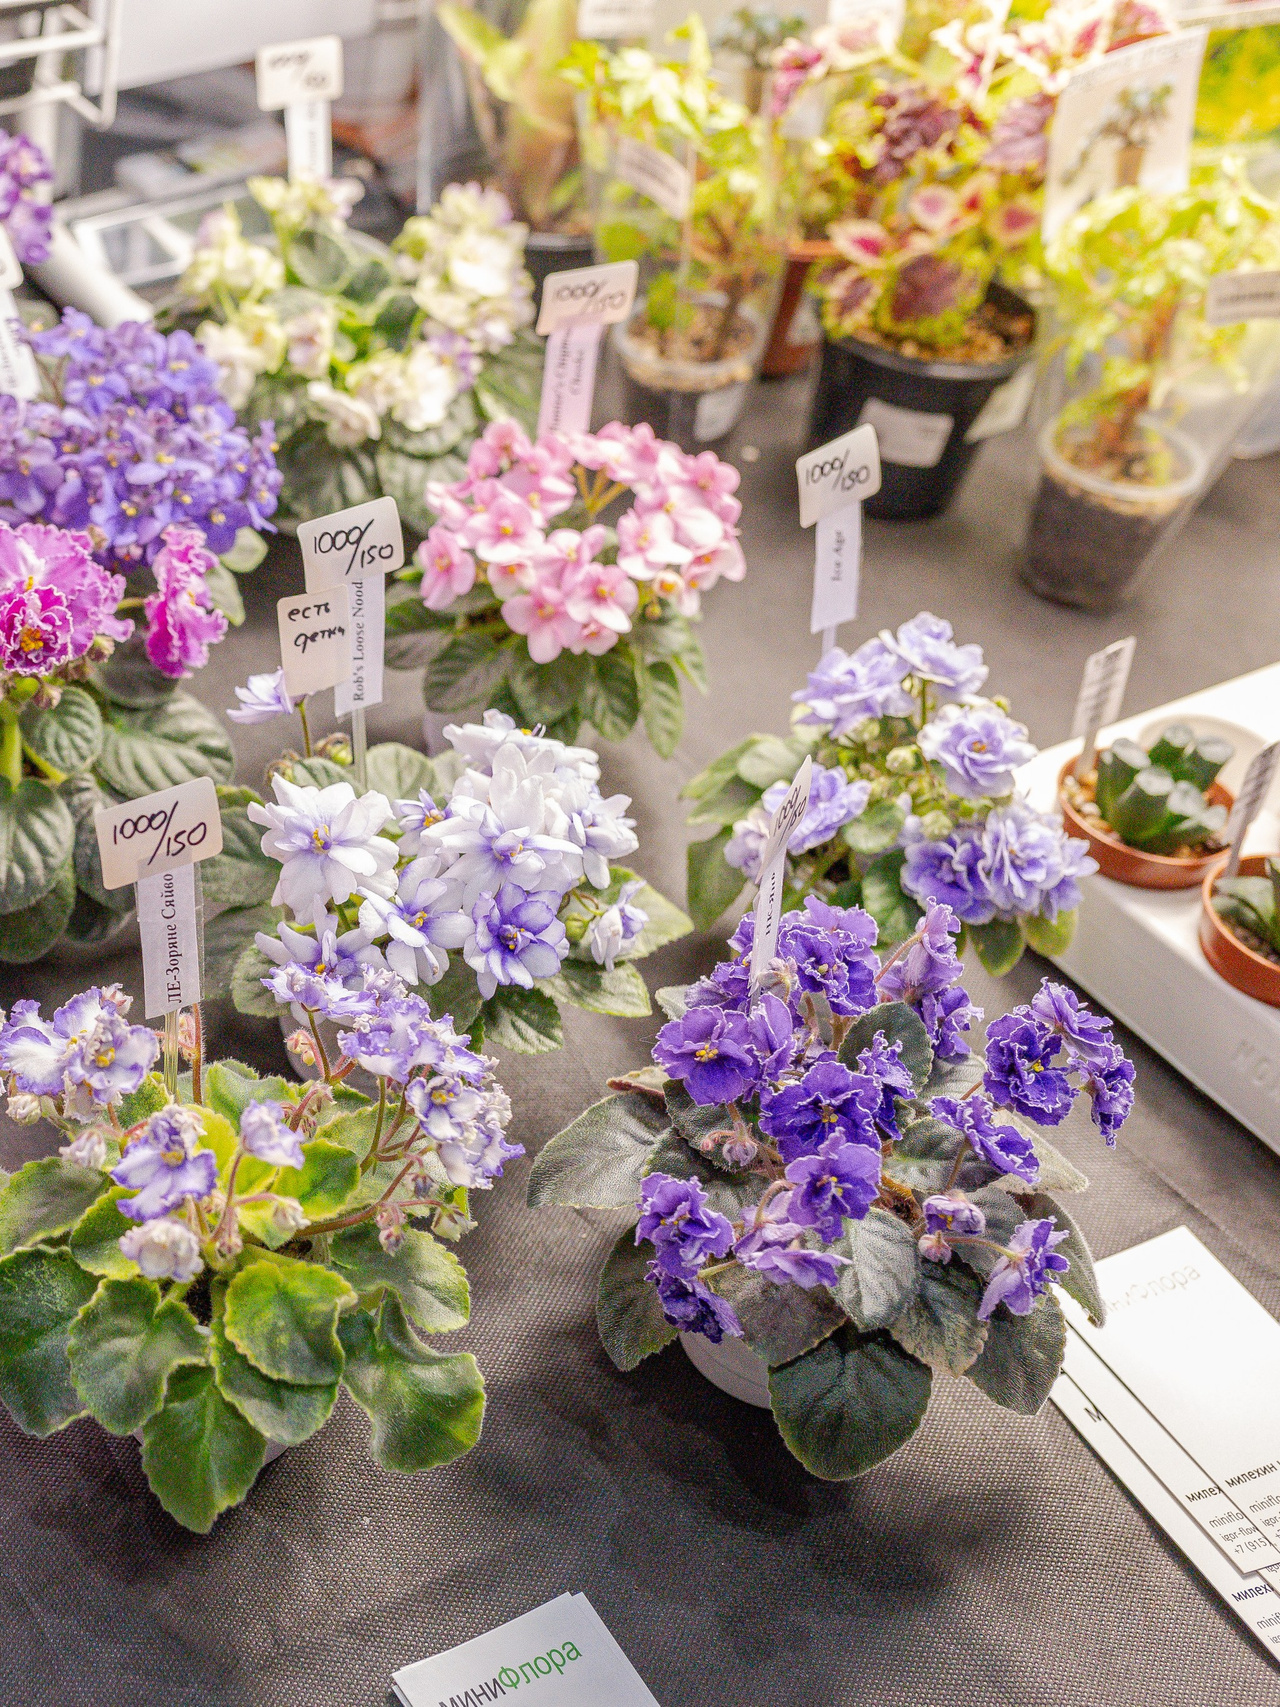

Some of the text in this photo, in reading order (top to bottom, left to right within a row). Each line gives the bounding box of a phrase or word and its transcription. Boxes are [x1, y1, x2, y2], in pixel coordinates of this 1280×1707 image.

[314, 519, 394, 576] 1000/150
[352, 623, 365, 662] Loose
[352, 665, 365, 702] Rob's
[113, 801, 207, 866] 1000/150
[161, 873, 182, 1004] ЛЕ-Зоряне Сяйво
[1224, 1463, 1278, 1488] милехин
